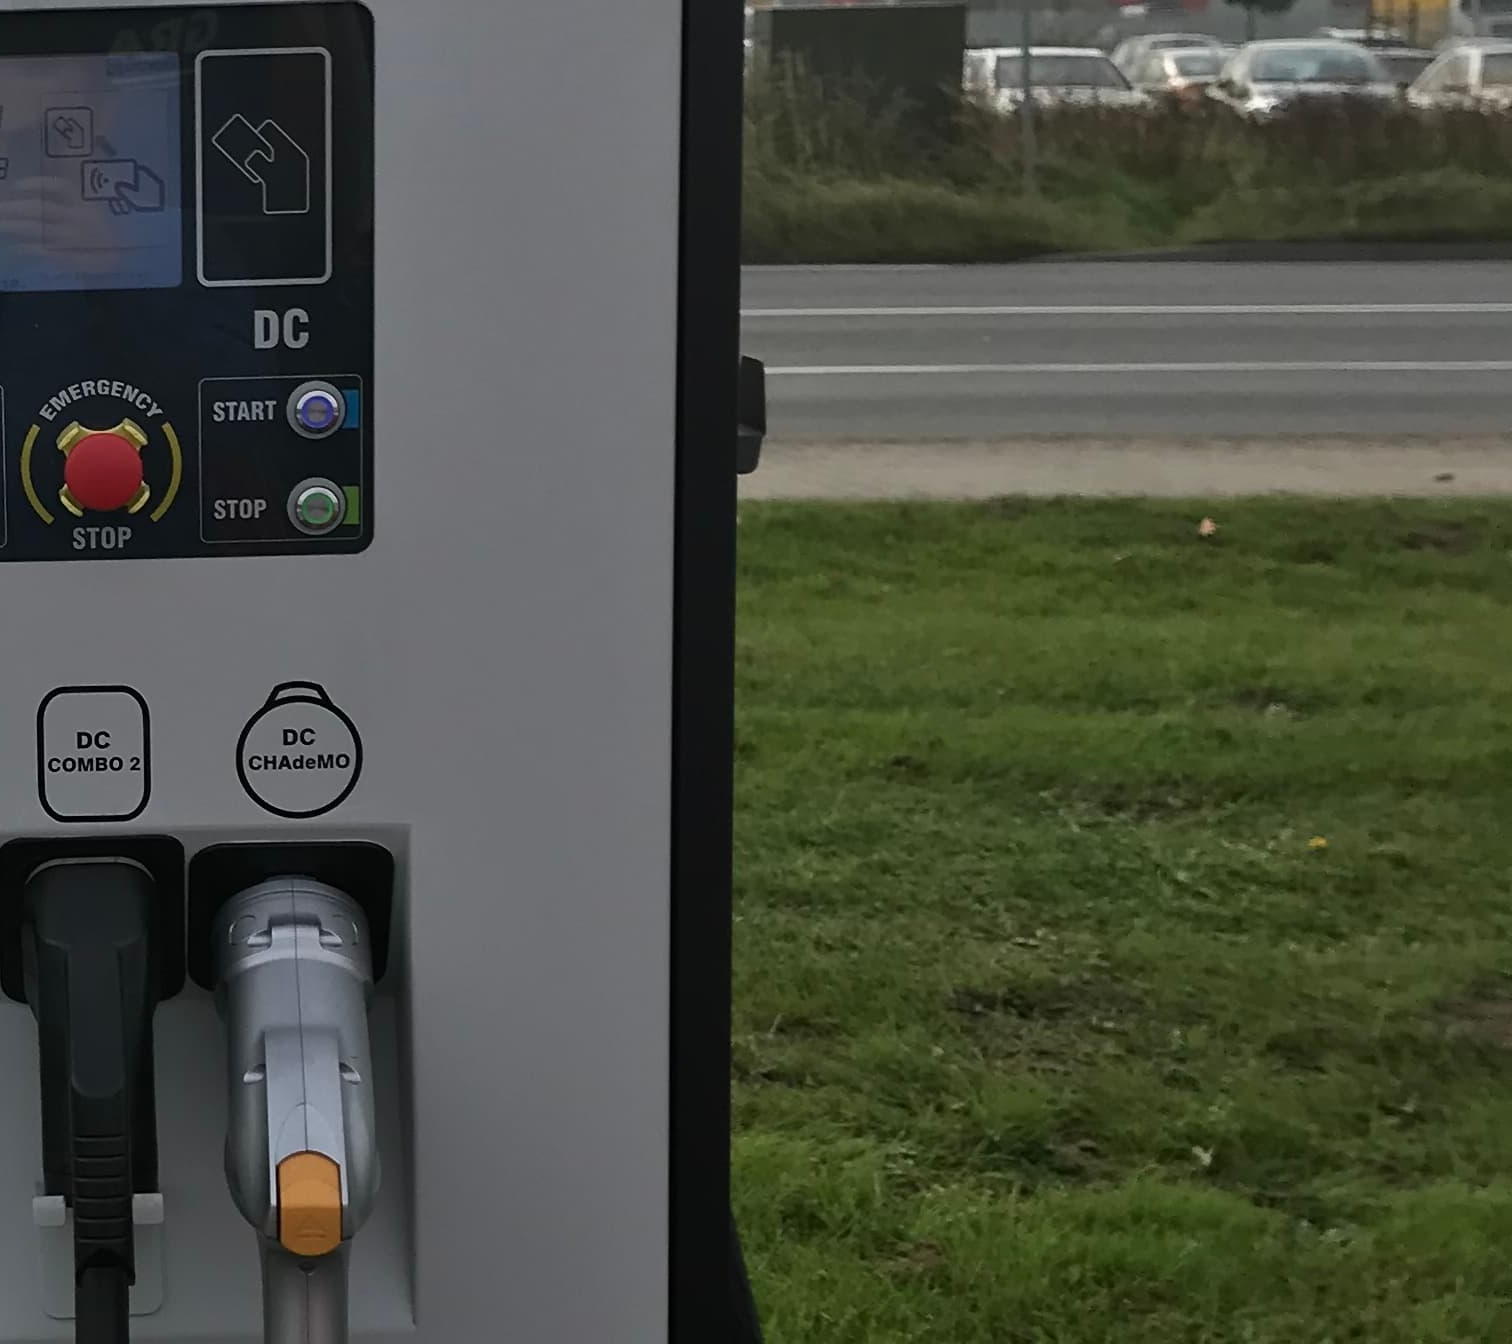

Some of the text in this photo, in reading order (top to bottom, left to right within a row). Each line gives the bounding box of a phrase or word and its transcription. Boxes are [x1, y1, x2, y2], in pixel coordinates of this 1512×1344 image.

[252, 308, 310, 350] DC
[38, 379, 165, 422] EMERGENCY
[211, 399, 277, 423] START
[213, 498, 267, 520] STOP
[71, 526, 132, 551] STOP
[75, 730, 110, 751] DC
[281, 728, 316, 747] DC
[47, 756, 141, 774] COMBO 2
[247, 752, 351, 772] CHAdeMO
